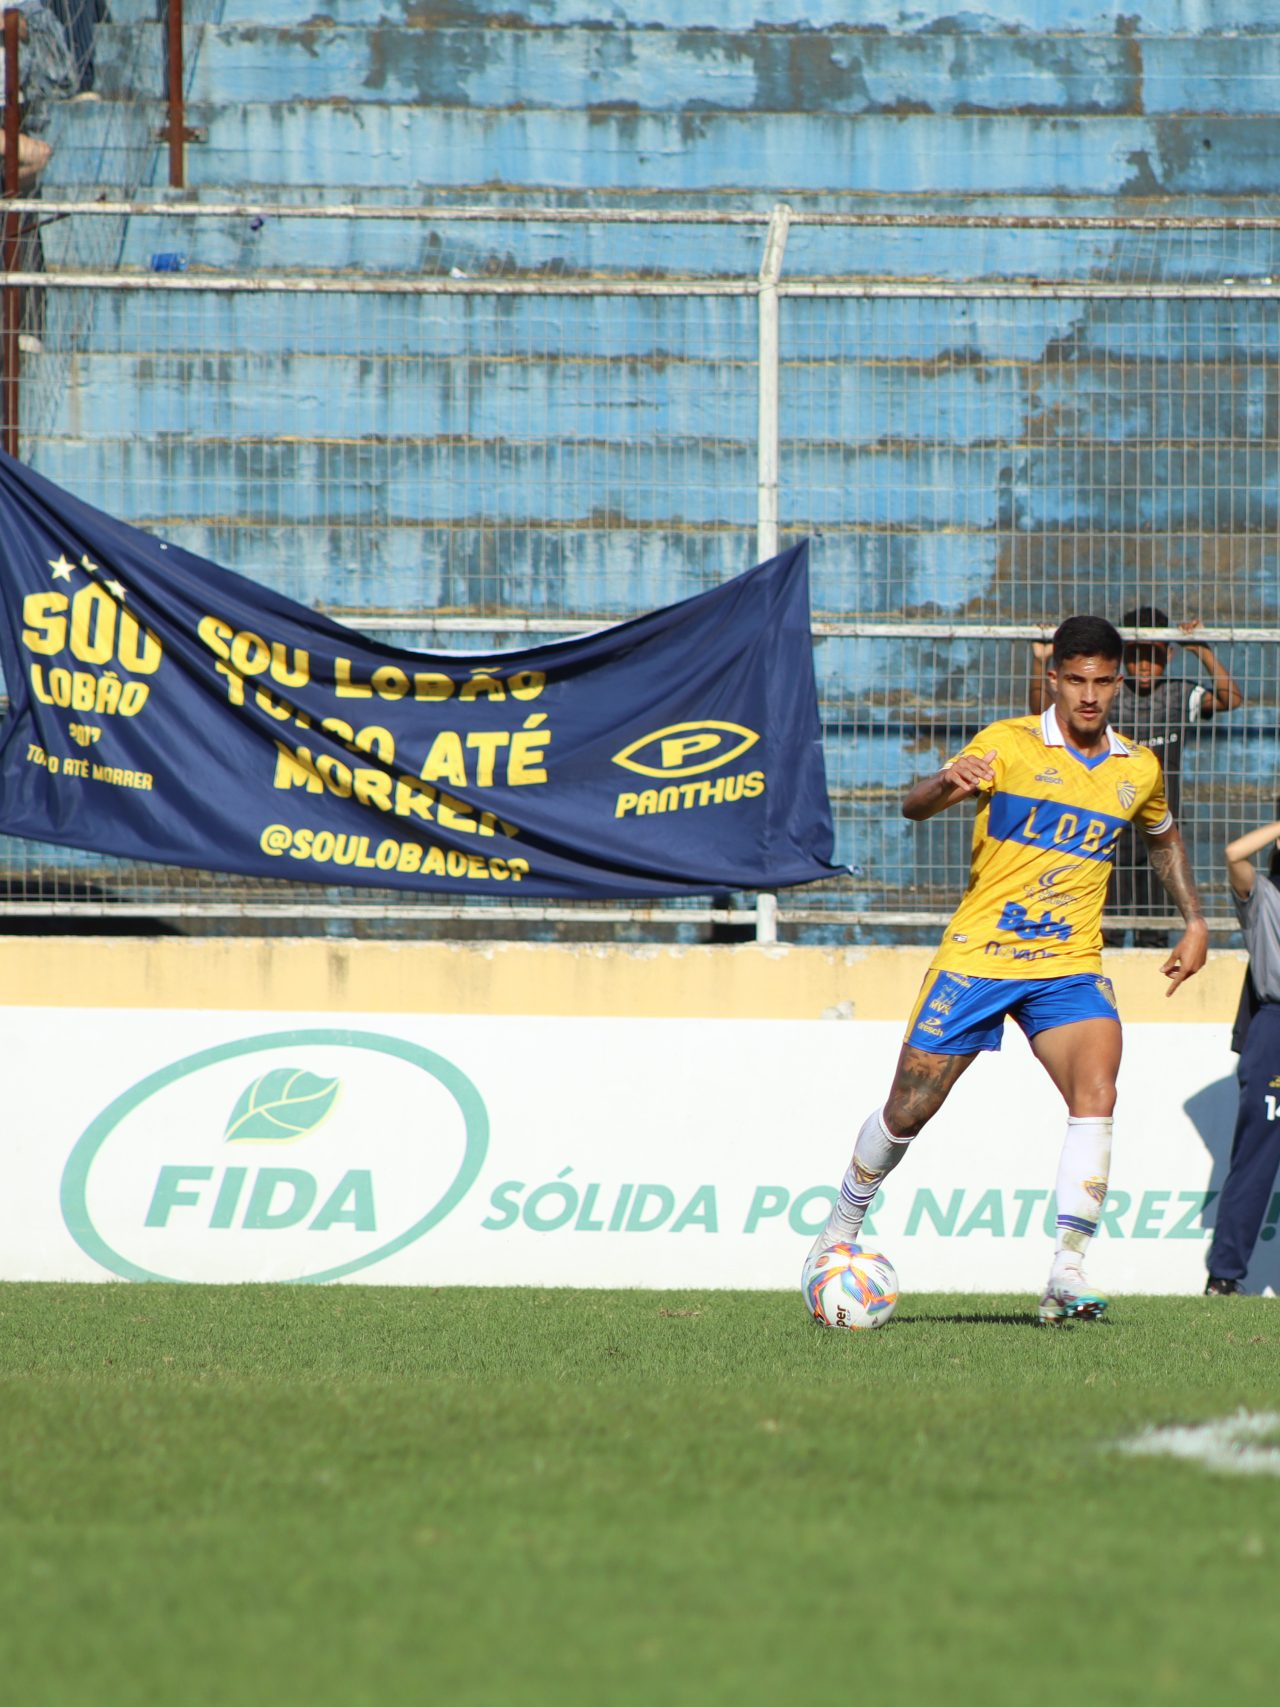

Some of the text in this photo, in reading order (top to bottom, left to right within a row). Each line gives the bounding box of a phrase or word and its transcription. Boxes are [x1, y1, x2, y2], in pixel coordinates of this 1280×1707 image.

[31, 664, 150, 717] LOBÃO
[198, 616, 546, 701] SOU LOBÃO
[63, 758, 89, 778] ATÉ
[420, 713, 551, 788] ATÉ
[614, 771, 765, 818] PANTHUS
[143, 1165, 378, 1232] FIDA
[481, 1166, 719, 1233] SÓLIDA
